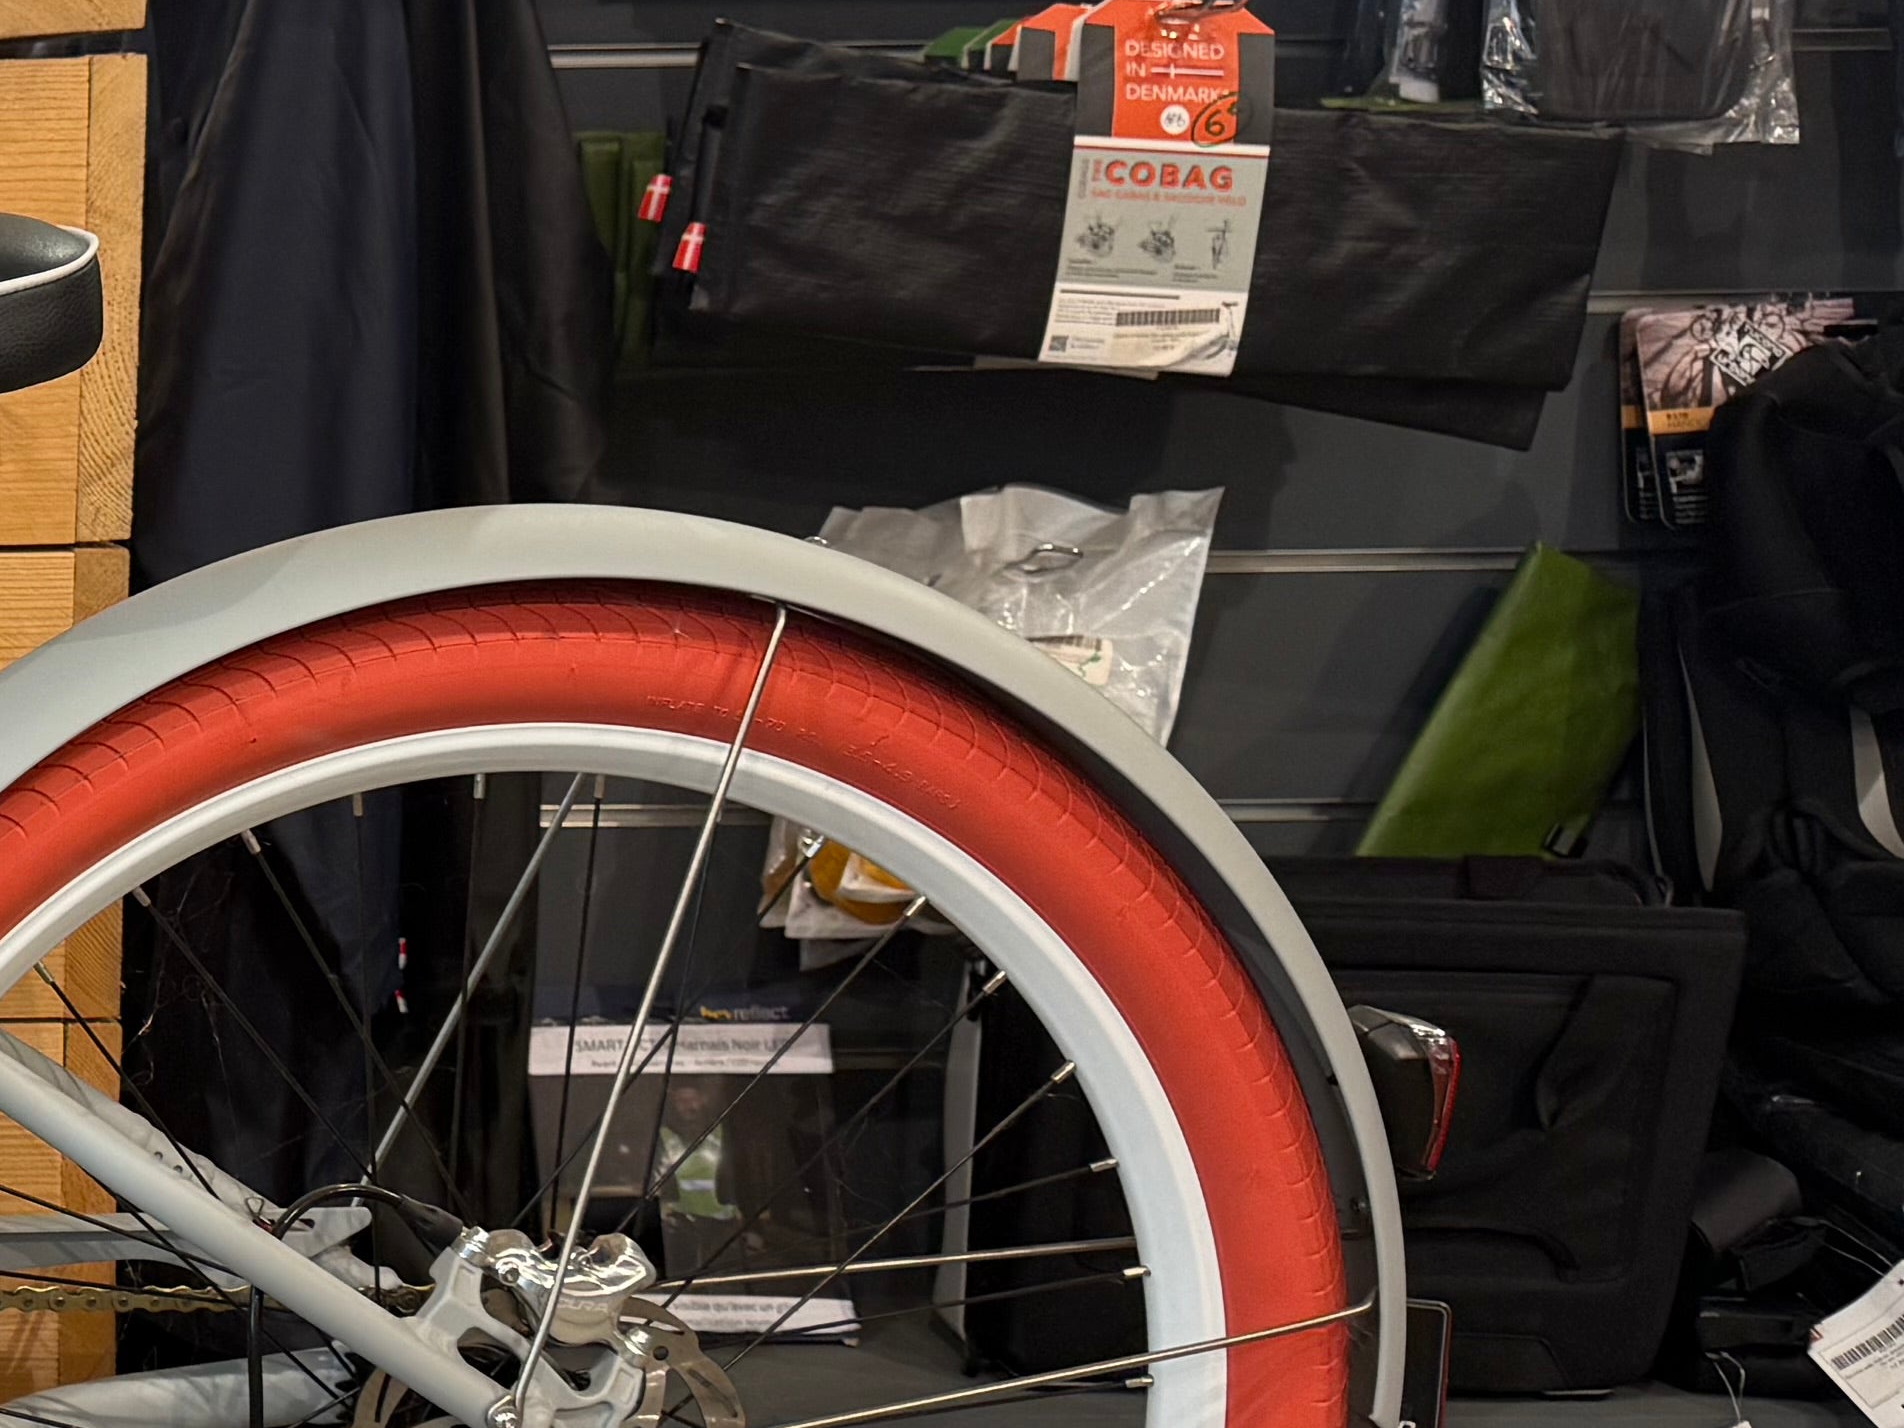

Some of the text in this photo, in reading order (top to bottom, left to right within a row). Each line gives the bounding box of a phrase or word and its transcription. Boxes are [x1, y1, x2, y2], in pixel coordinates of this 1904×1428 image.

[1124, 39, 1225, 60] DESIGNED
[1125, 61, 1147, 77] IN
[1125, 83, 1220, 103] DENMARK
[1104, 159, 1235, 193] COBAG
